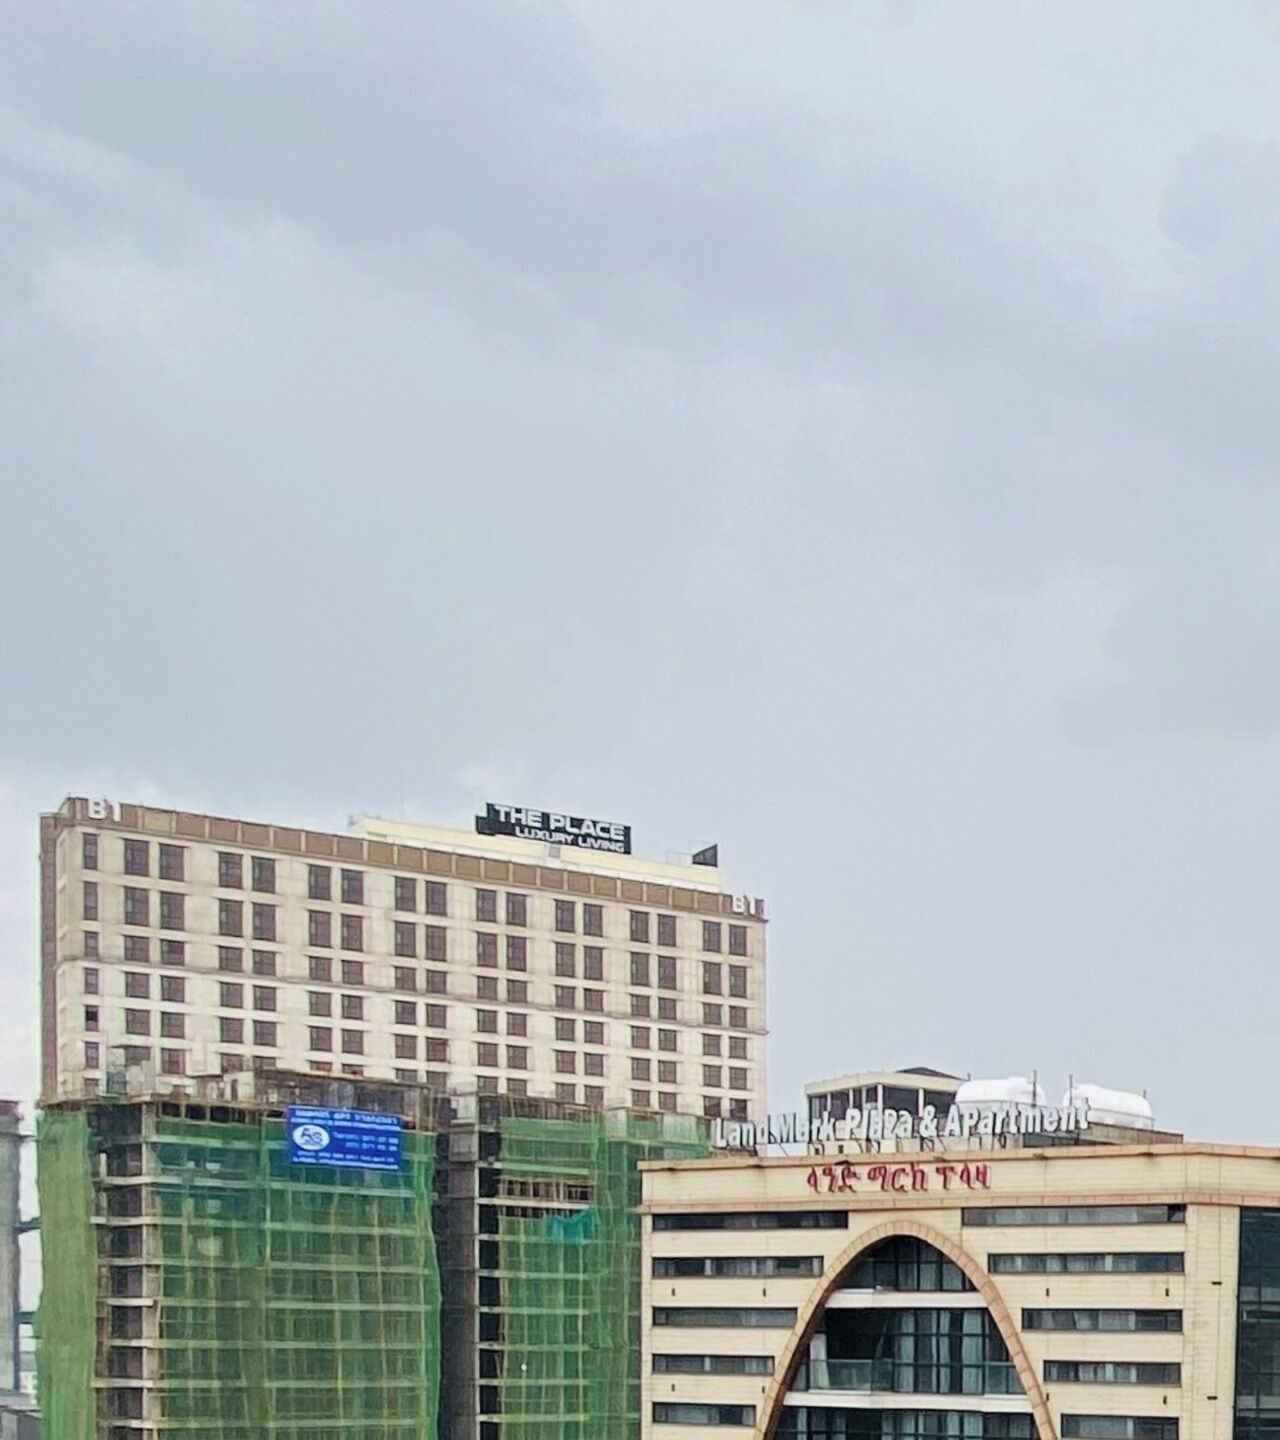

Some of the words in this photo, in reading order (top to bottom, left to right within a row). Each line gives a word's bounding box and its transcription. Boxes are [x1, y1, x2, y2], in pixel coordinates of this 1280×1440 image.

[494, 804, 542, 827] THE
[549, 813, 625, 841] PLACE
[515, 826, 575, 845] LUXURY
[577, 835, 625, 852] LIVING
[712, 1113, 771, 1148] Land
[774, 1110, 836, 1143] Mark
[845, 1106, 913, 1140] Plaza
[919, 1104, 938, 1138] &
